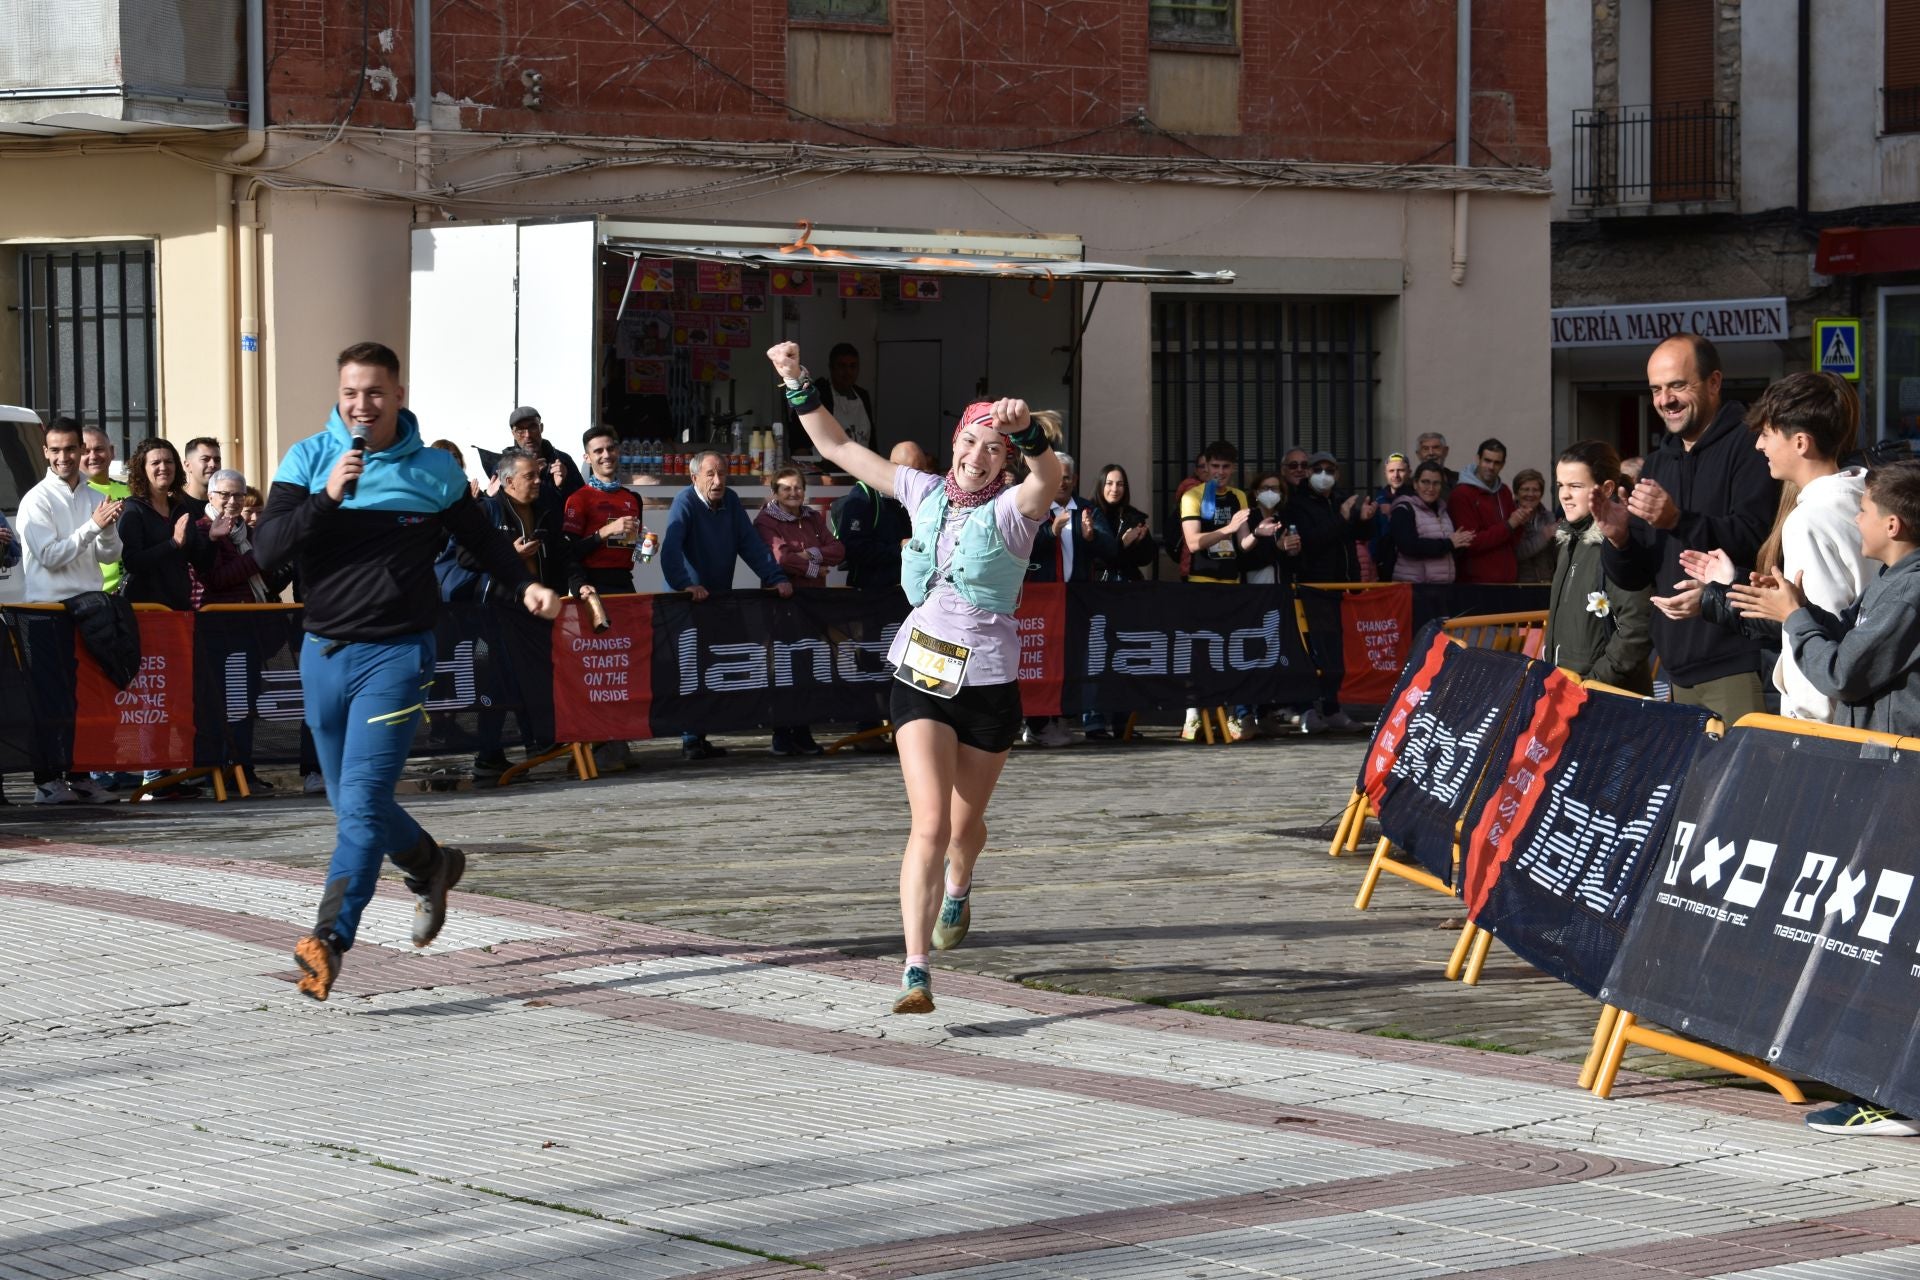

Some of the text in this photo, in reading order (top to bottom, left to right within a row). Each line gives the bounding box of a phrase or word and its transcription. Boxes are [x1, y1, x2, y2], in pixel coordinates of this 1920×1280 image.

[1552, 307, 1782, 343] ICERÍA MARY CARMEN
[1017, 617, 1045, 631] NGES
[573, 637, 632, 652] CHANGES
[1017, 634, 1045, 648] ARTS
[1087, 609, 1281, 676] land
[582, 654, 630, 669] STARTS
[1022, 650, 1043, 664] THE
[129, 674, 166, 689] ARTS
[225, 640, 476, 723] lad
[584, 671, 628, 686] ON THE
[1017, 667, 1043, 681] SIDE
[114, 690, 167, 707] ON THE
[589, 689, 629, 703] INSIDE
[120, 709, 169, 724] INSIDE
